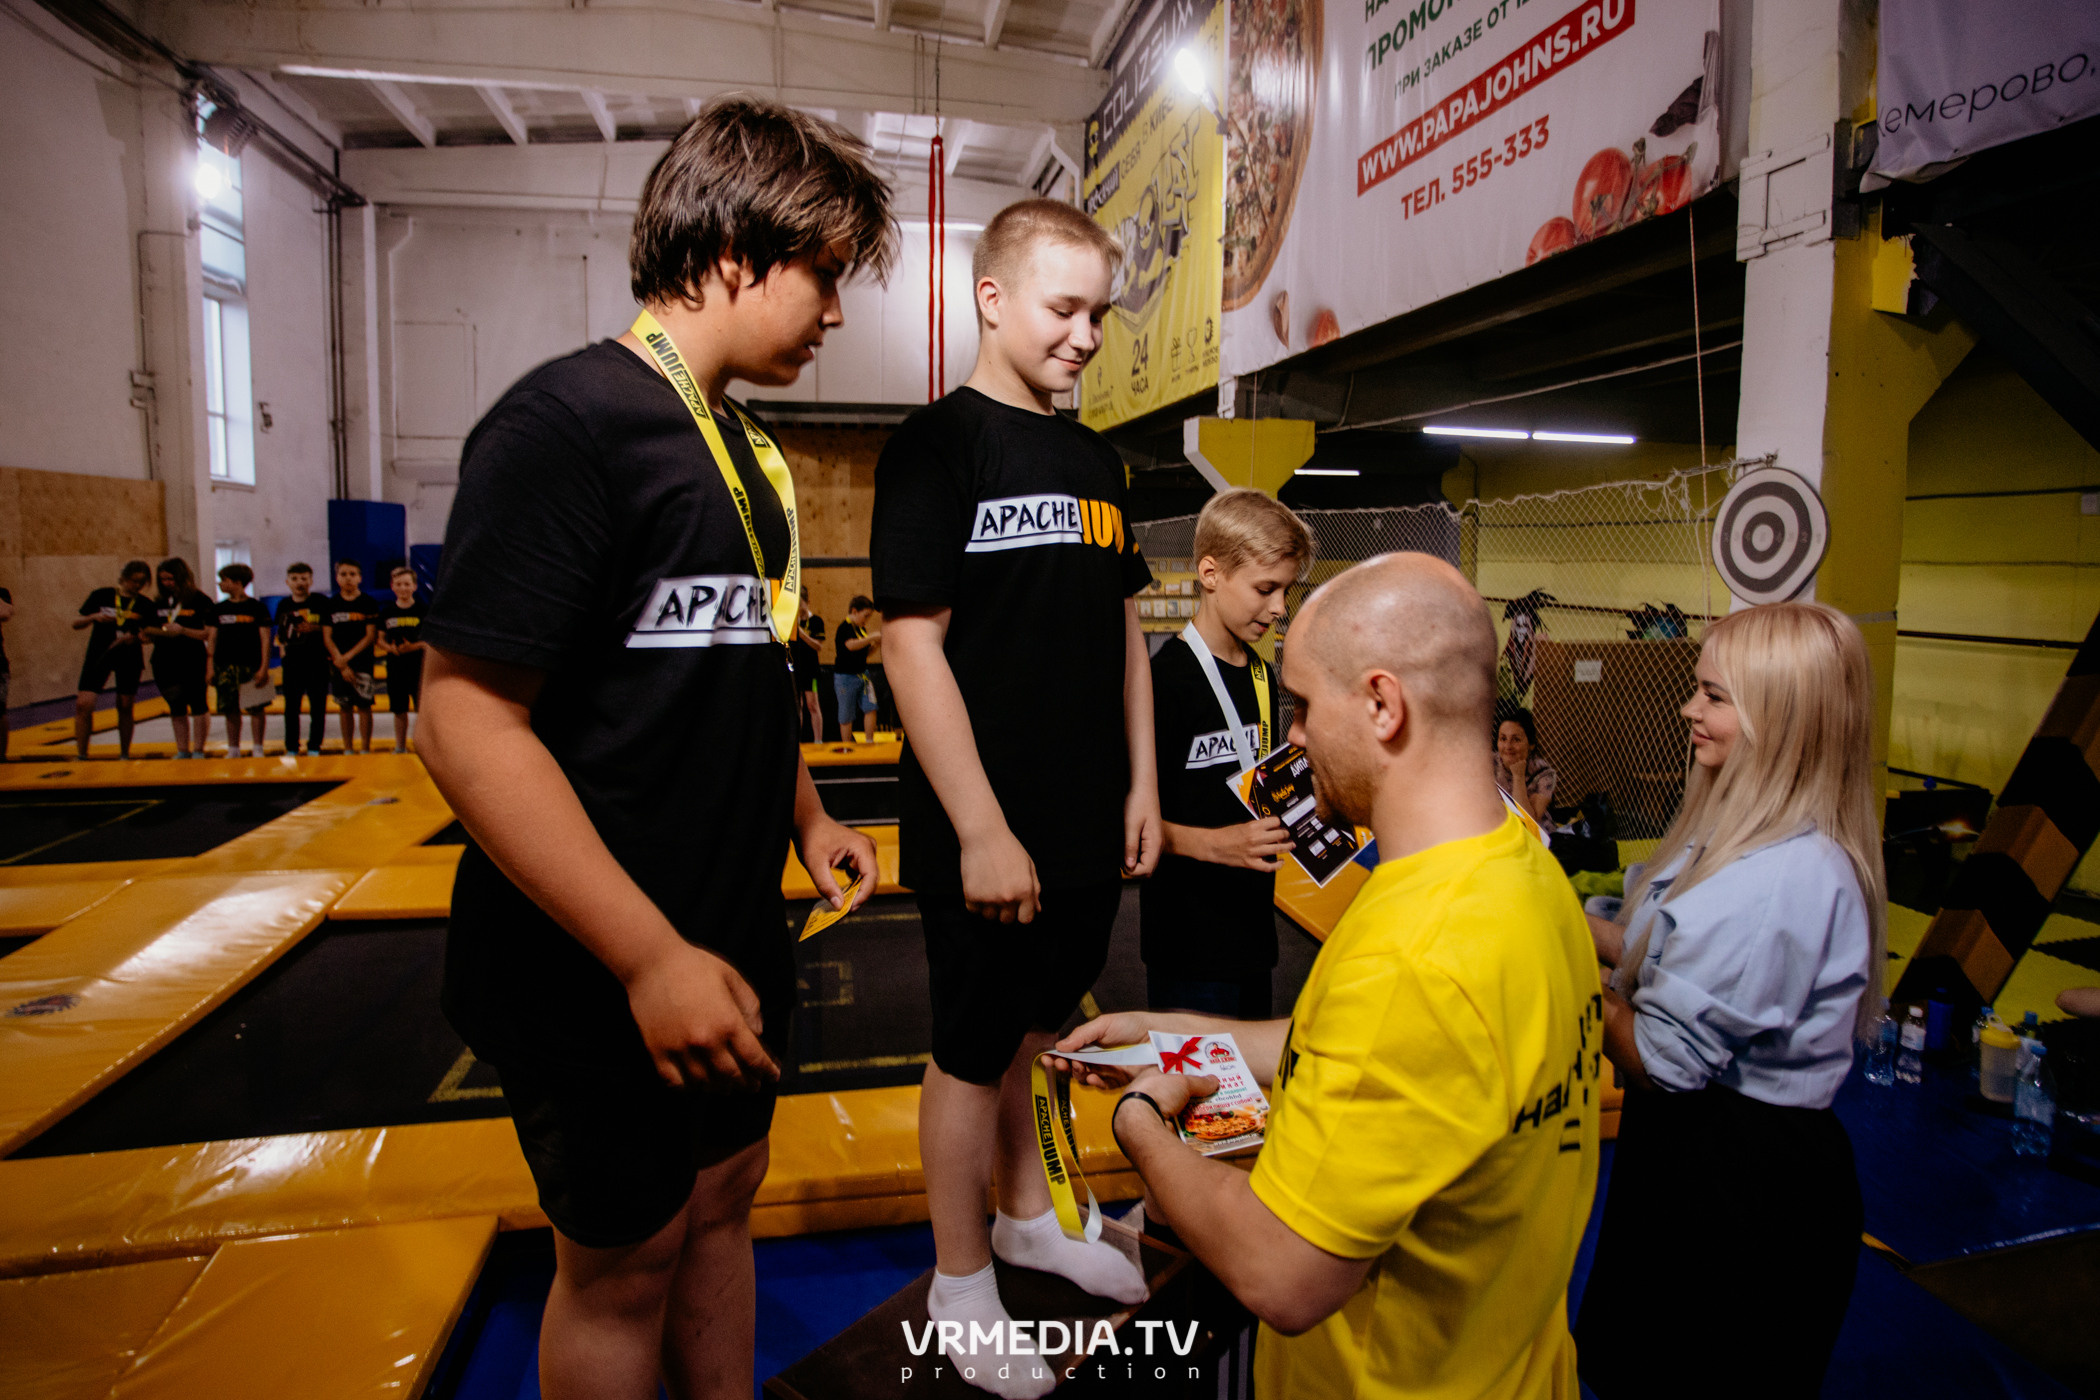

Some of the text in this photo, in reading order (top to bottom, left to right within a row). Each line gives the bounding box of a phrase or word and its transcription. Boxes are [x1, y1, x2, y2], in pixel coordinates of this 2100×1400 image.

[1424, 19, 1483, 78] ЗАКАЗЕ
[1487, 0, 1508, 29] ОТ
[1361, 0, 1626, 186] WWW.PAPAJOHNS.RU
[1401, 114, 1550, 220] ТЕЛ. 555-333
[1131, 333, 1149, 378] 24
[1131, 376, 1150, 397] ЧАСА
[981, 502, 1078, 537] APACHE
[1038, 1098, 1066, 1186] APACHE JUMP
